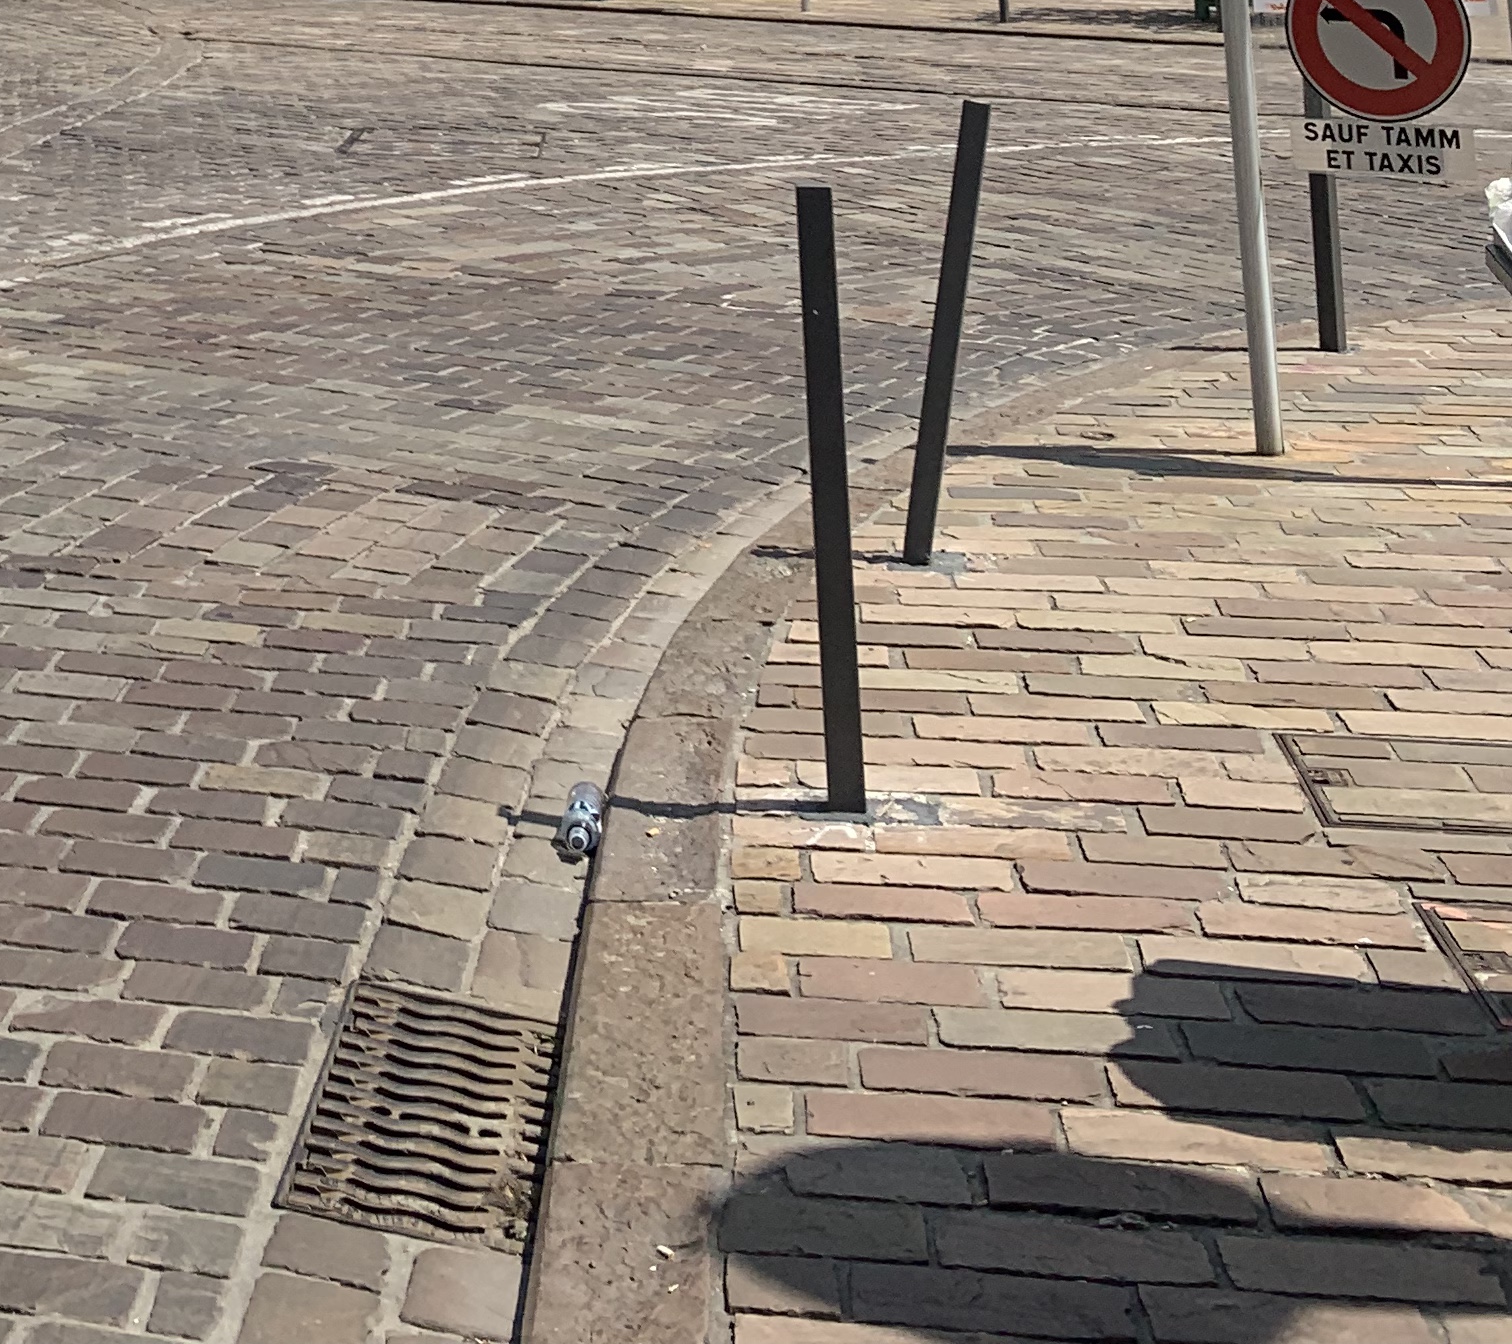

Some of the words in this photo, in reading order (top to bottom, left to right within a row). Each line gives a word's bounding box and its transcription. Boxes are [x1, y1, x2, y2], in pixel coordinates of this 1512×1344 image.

[1303, 121, 1370, 144] SAUF
[1381, 125, 1461, 150] TAMM
[1326, 149, 1355, 170] ET
[1364, 151, 1442, 175] TAXIS
